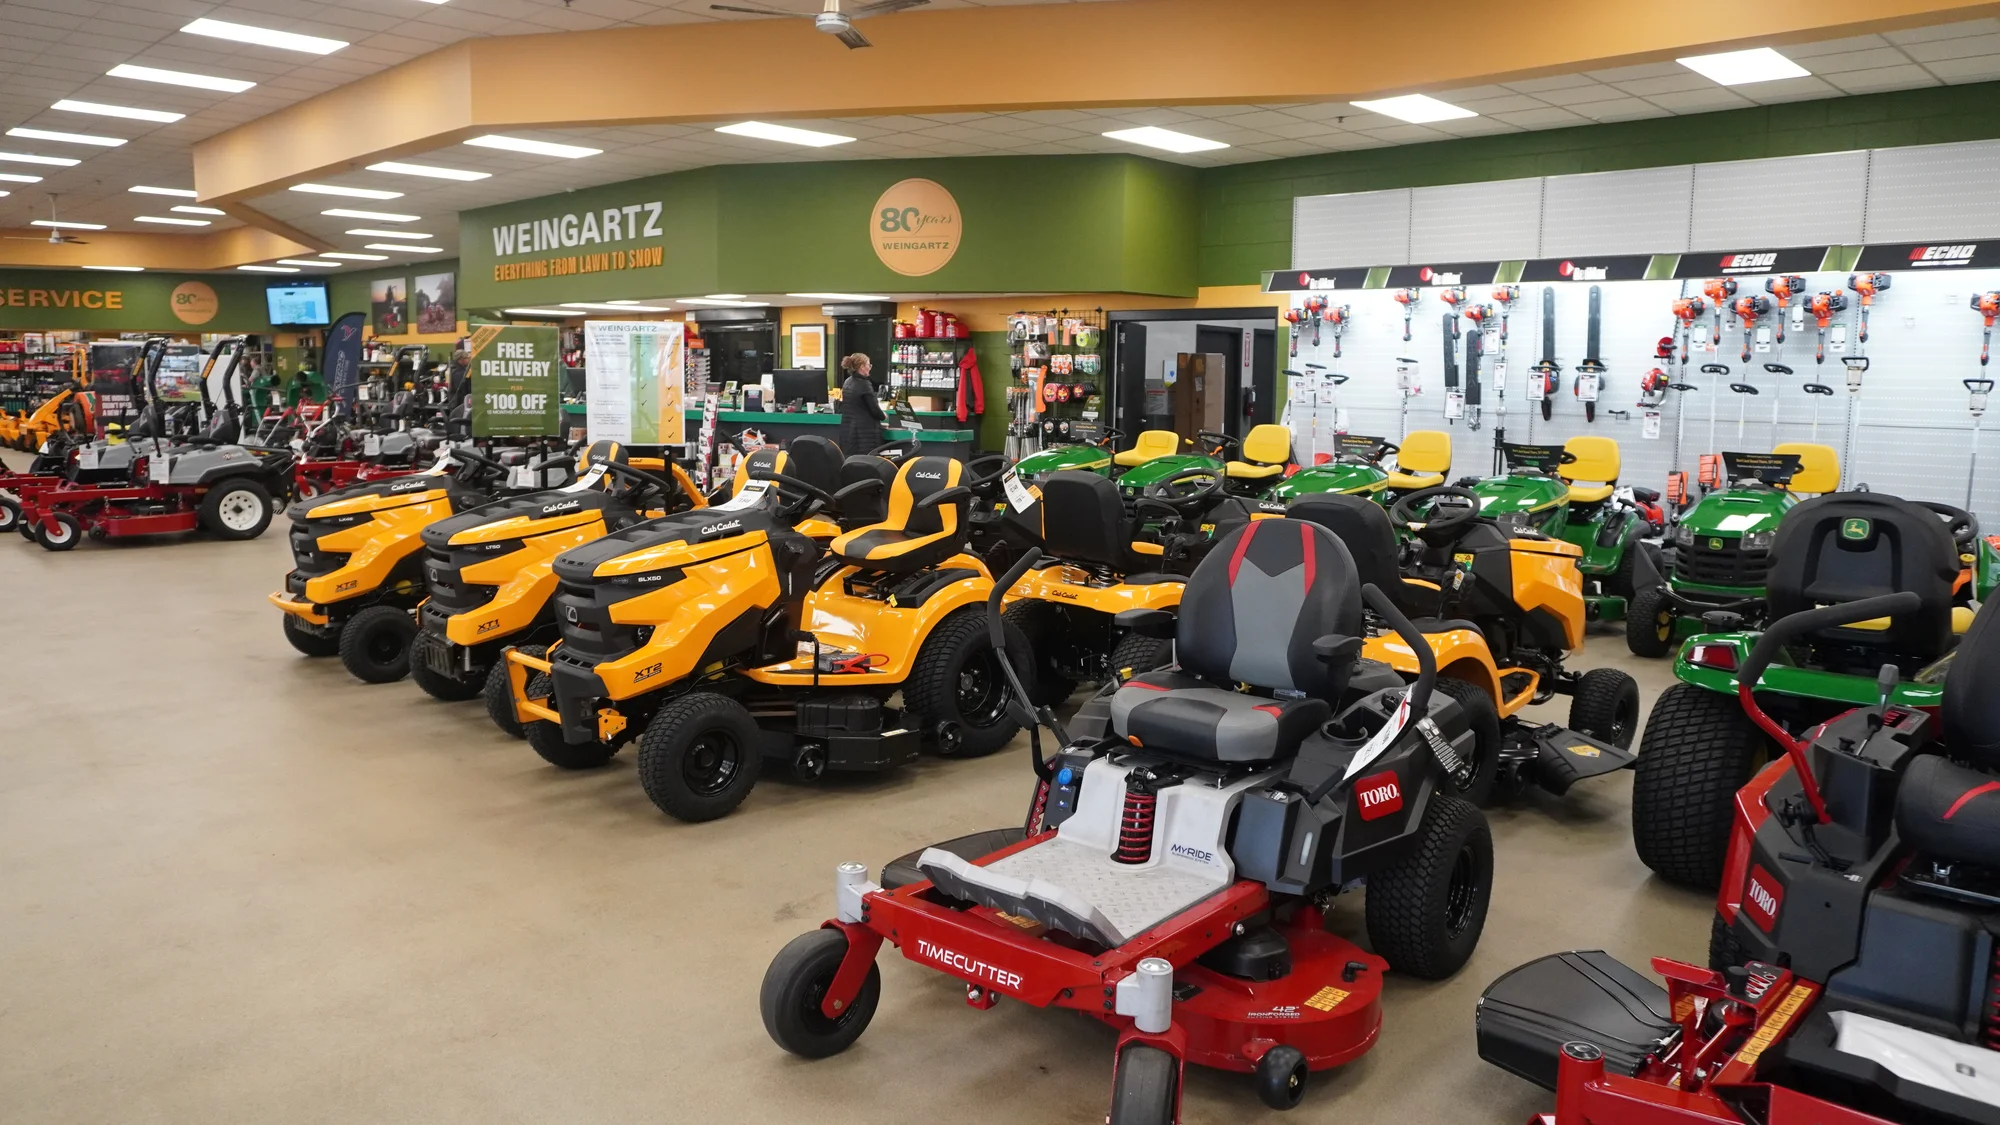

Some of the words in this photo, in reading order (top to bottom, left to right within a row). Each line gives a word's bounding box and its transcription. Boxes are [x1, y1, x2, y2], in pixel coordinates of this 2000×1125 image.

[880, 207, 920, 232] 80
[493, 201, 663, 256] WEINGARTZ
[882, 242, 949, 250] WEINGARTZ
[1921, 245, 1977, 260] ECHO
[494, 259, 548, 282] EVERYTHING
[551, 256, 577, 276] FROM
[579, 252, 609, 273] LAWN
[612, 250, 626, 269] TO
[629, 246, 663, 268] SNOW
[1731, 253, 1777, 267] ECHO
[497, 342, 534, 358] FREE
[480, 360, 551, 377] DELIVERY
[485, 393, 517, 409] $100
[521, 394, 547, 409] OFF
[405, 480, 426, 489] Cadet
[543, 504, 557, 512] Cub
[557, 500, 580, 510] Cadet
[701, 525, 717, 534] Cub
[717, 520, 741, 531] Cadet
[478, 619, 499, 630] XT1
[634, 662, 662, 678] XT2
[1360, 783, 1399, 808] TORO
[1749, 878, 1776, 915] TORO
[918, 940, 1022, 989] TIMECUTTER
